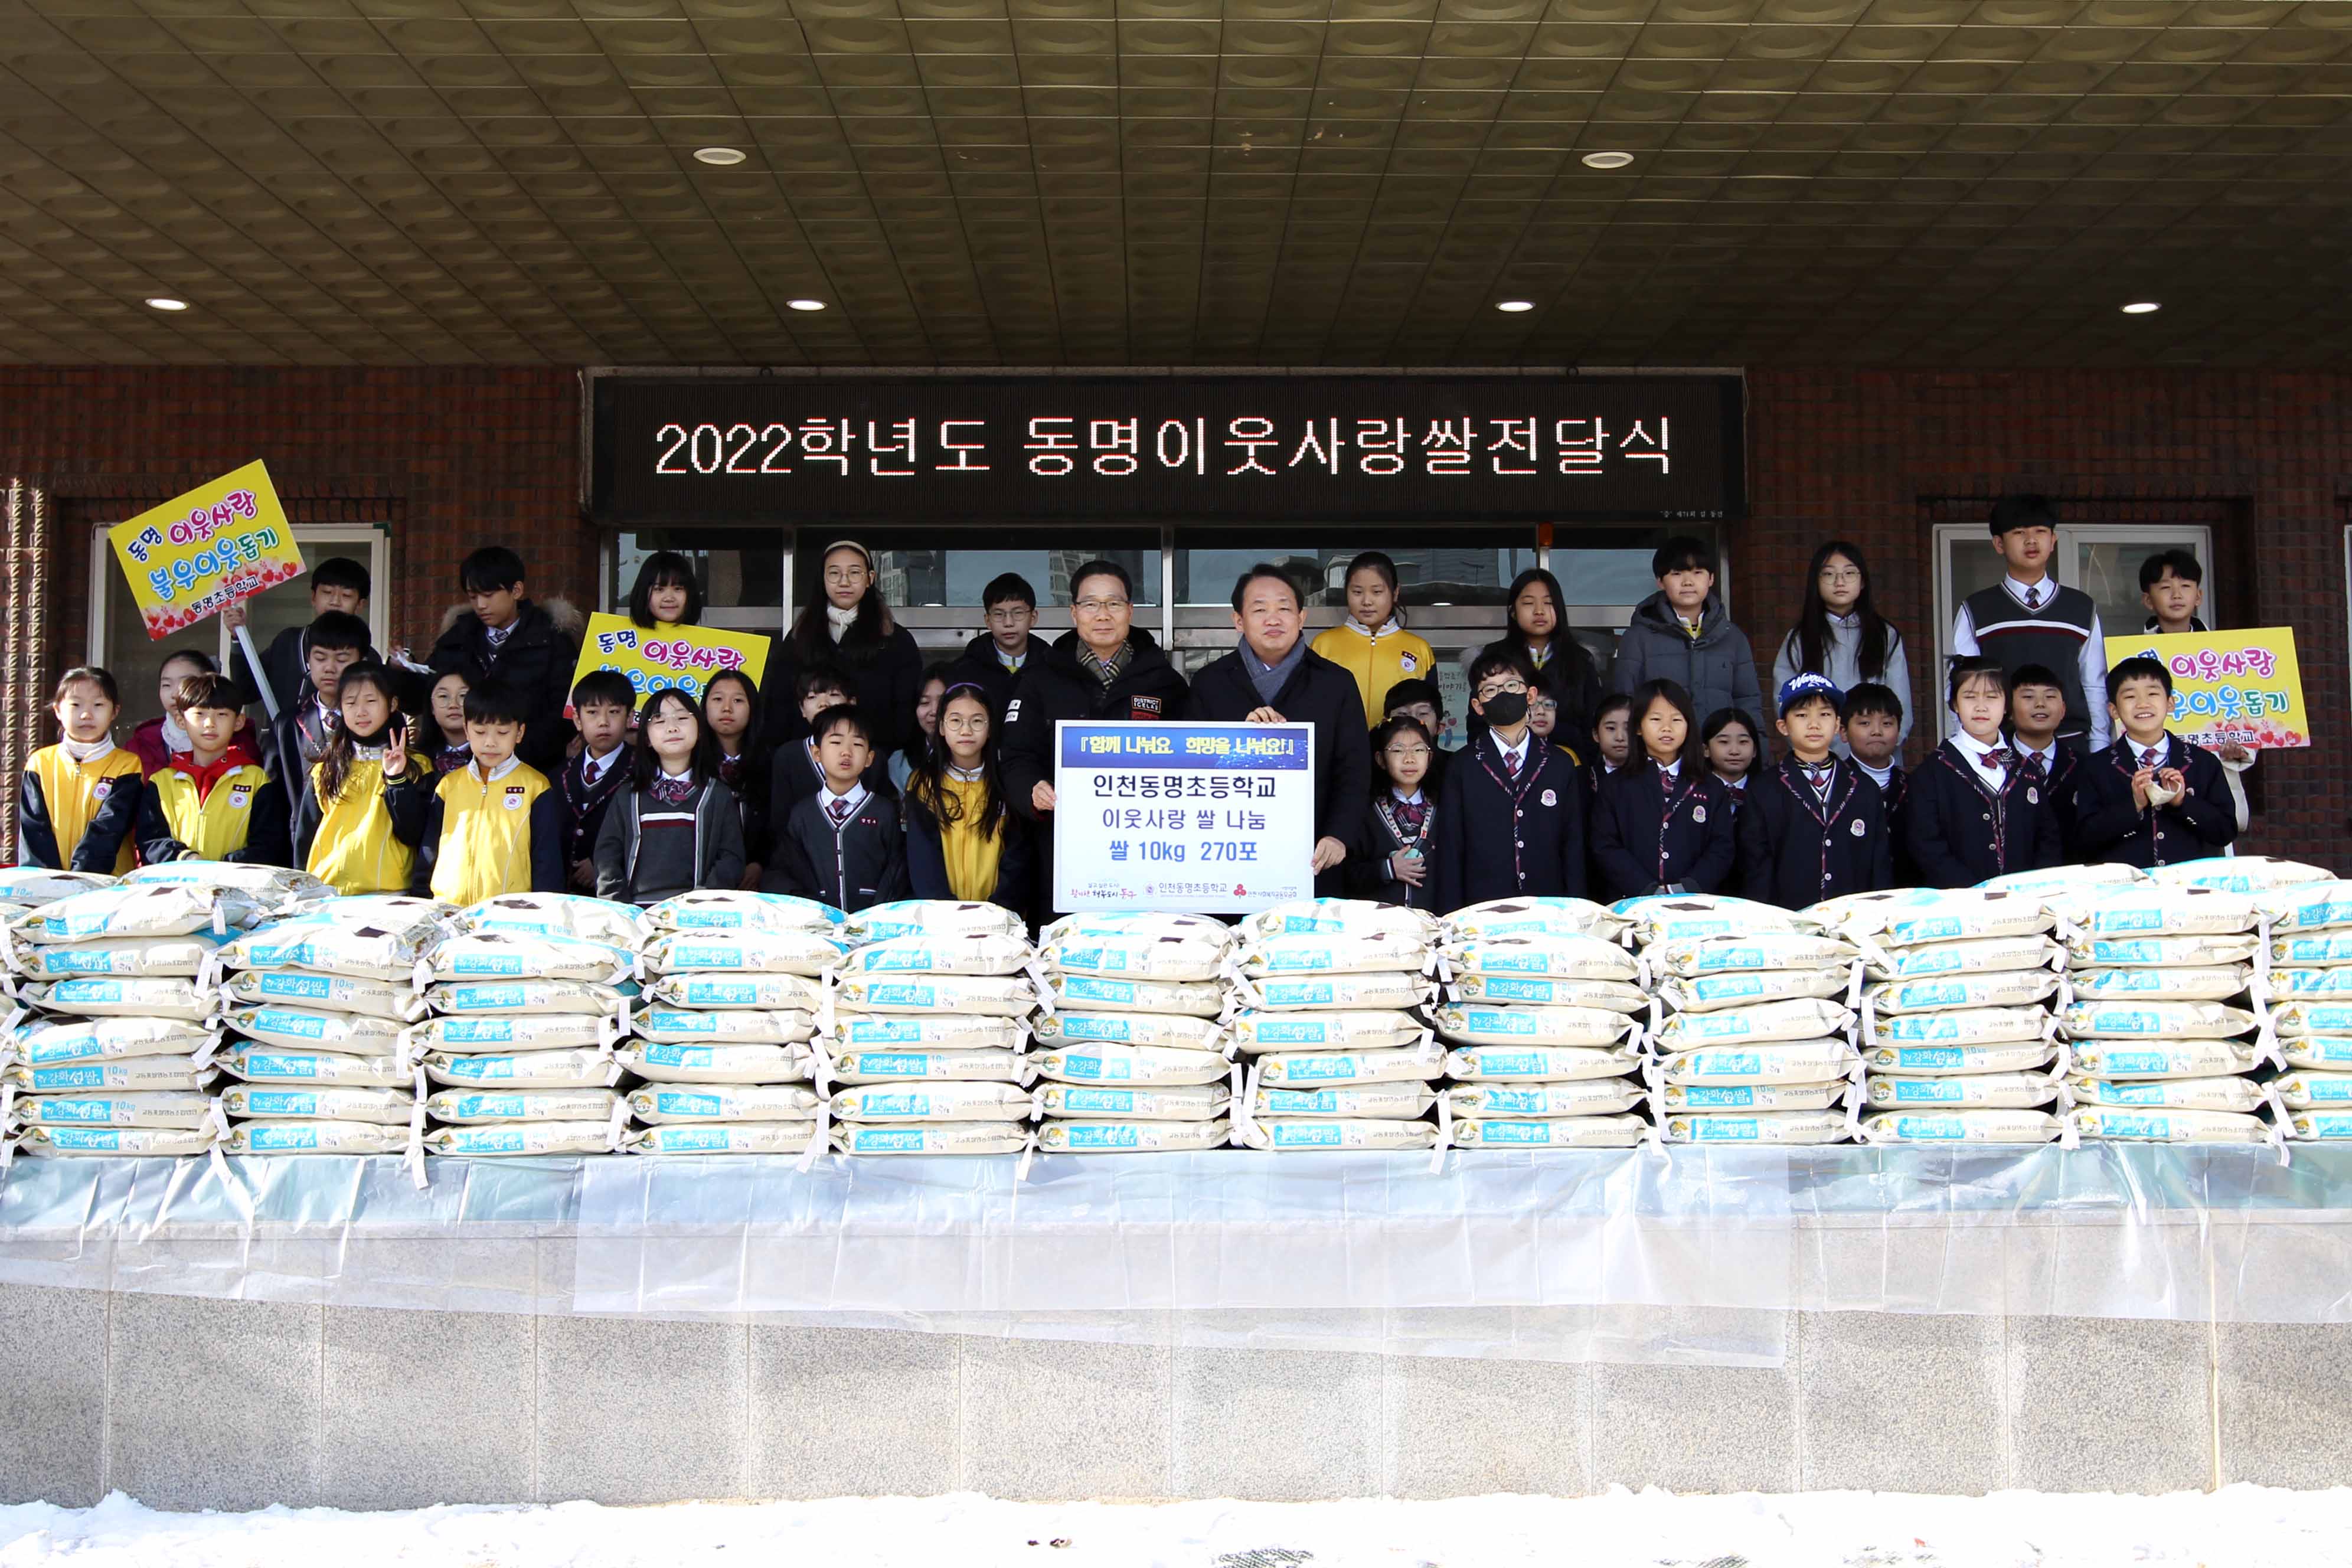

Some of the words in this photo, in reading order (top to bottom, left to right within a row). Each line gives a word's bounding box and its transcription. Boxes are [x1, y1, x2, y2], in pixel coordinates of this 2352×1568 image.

[655, 418, 990, 476] 2022학년도
[1023, 417, 1669, 475] 동명이웃사랑쌀전달식
[127, 525, 163, 563] 동명
[167, 489, 257, 544] 이웃사랑
[148, 526, 280, 602] 불우이웃돕기
[191, 576, 259, 615] 동명초등학교
[597, 628, 638, 654] 동명
[641, 639, 747, 671] 이웃사랑
[2170, 648, 2278, 681] 이웃사랑
[1185, 737, 1231, 755] 희망을
[1093, 775, 1276, 799] 인천동명초등학교
[1102, 809, 1186, 830] 이웃사랑
[1196, 809, 1216, 829] 쌀
[1227, 810, 1266, 830] 나눔
[1109, 841, 1129, 861] 쌀
[1139, 842, 1185, 862] 10kg
[1200, 842, 1258, 862] 270포
[1158, 883, 1227, 894] 인천동명초등학교
[276, 975, 323, 996] 강화섬쌀
[334, 978, 355, 989] 10kg
[1081, 981, 1127, 1001] 강화섬쌀
[1501, 981, 1546, 999] 강화섬쌀
[1079, 1021, 1125, 1037] 강화섬쌀
[1272, 1025, 1318, 1040] 강화섬쌀
[1484, 1015, 1530, 1032] 강화섬쌀
[1911, 1045, 1959, 1064] 강화섬쌀
[1965, 1047, 1988, 1055] 10kg
[875, 1057, 921, 1073] 강화섬쌀
[1497, 1058, 1543, 1073] 강화섬쌀
[49, 1069, 97, 1085] 강화섬쌀
[107, 1066, 128, 1076] 10kg
[264, 1096, 310, 1112] 강화섬쌀
[1080, 1093, 1126, 1109] 강화섬쌀
[1701, 1089, 1747, 1104] 강화섬쌀
[1756, 1086, 1776, 1095] 10kg
[57, 1103, 104, 1118] 강화섬쌀
[115, 1100, 136, 1111] 10kg
[871, 1133, 917, 1148] 강화섬쌀
[1084, 1129, 1131, 1145] 강화섬쌀
